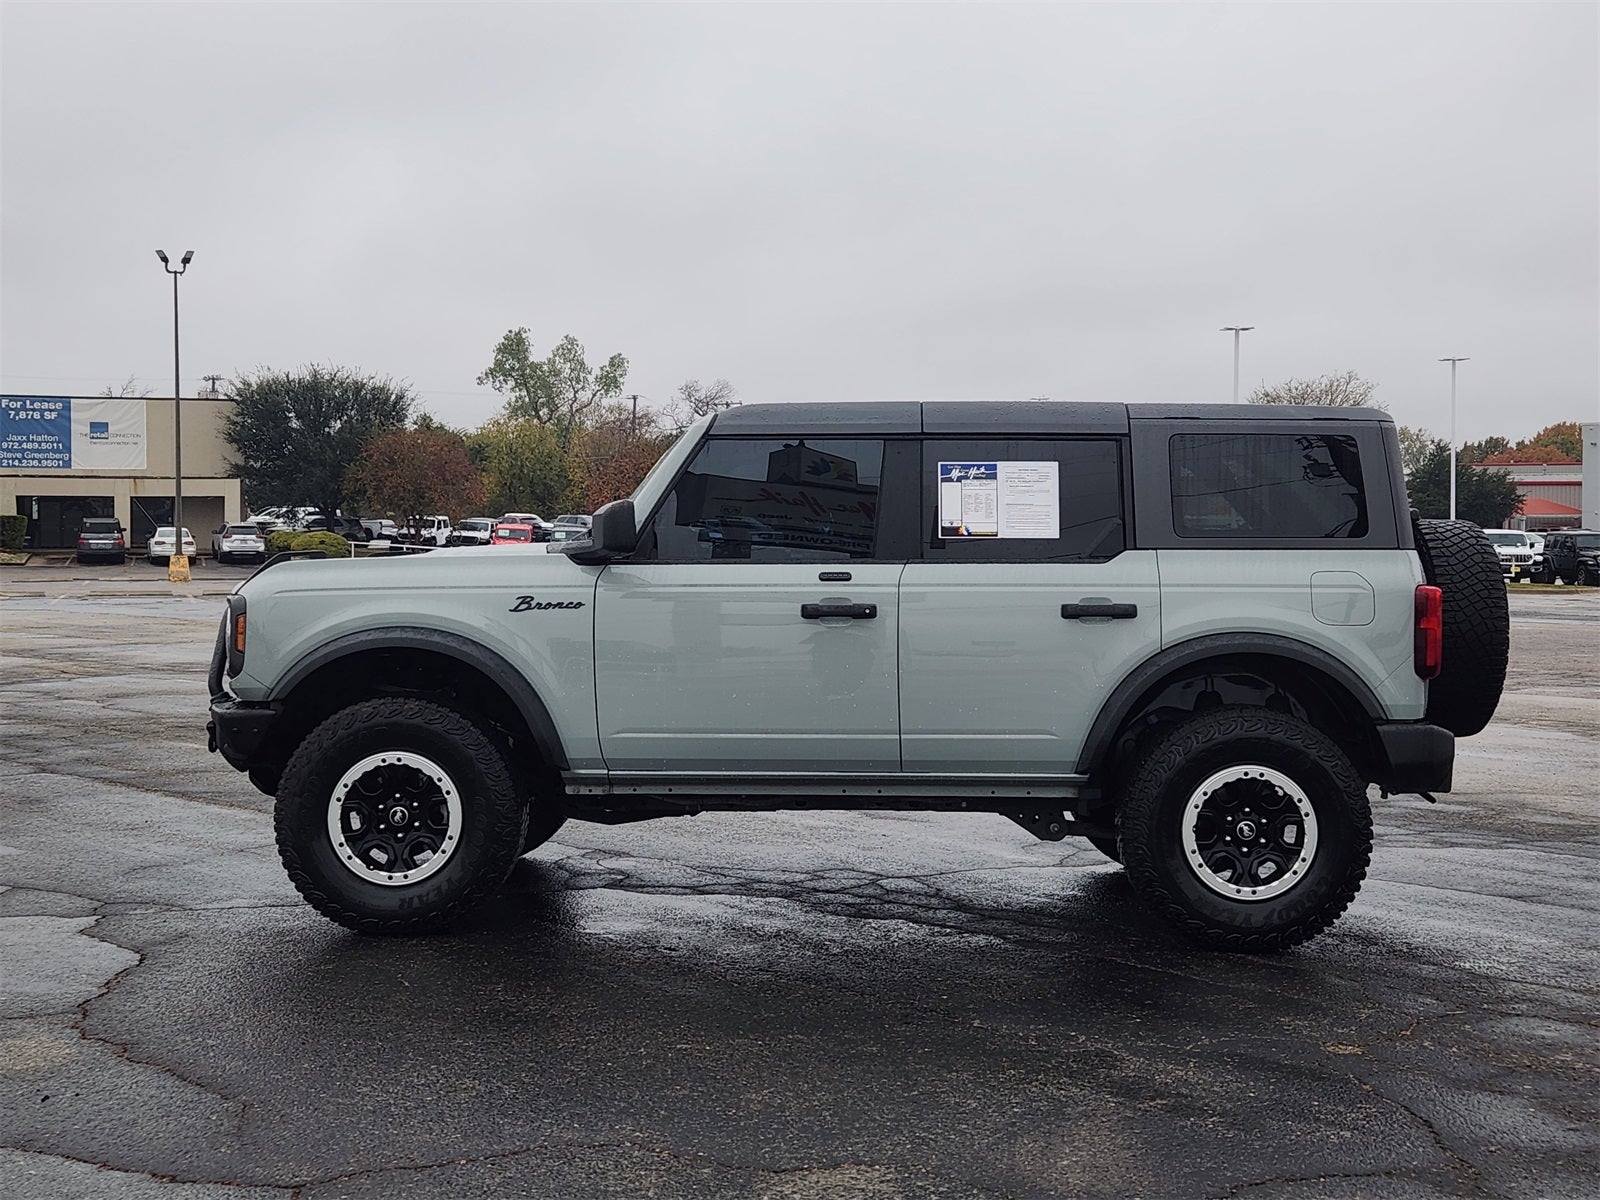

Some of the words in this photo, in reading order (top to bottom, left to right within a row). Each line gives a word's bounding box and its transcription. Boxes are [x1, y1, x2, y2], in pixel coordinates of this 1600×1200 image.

[1, 399, 21, 409] For
[26, 399, 63, 410] Lease
[8, 411, 41, 421] 7,878
[44, 411, 58, 420] SF
[6, 433, 27, 441] Jaxx
[29, 433, 59, 442] Hatton
[1, 442, 63, 450] 972.489.5011
[0, 451, 22, 459] Steve
[24, 451, 70, 461] Greenberg
[1, 459, 63, 467] 214.236.9501
[508, 595, 586, 612] Bronco
